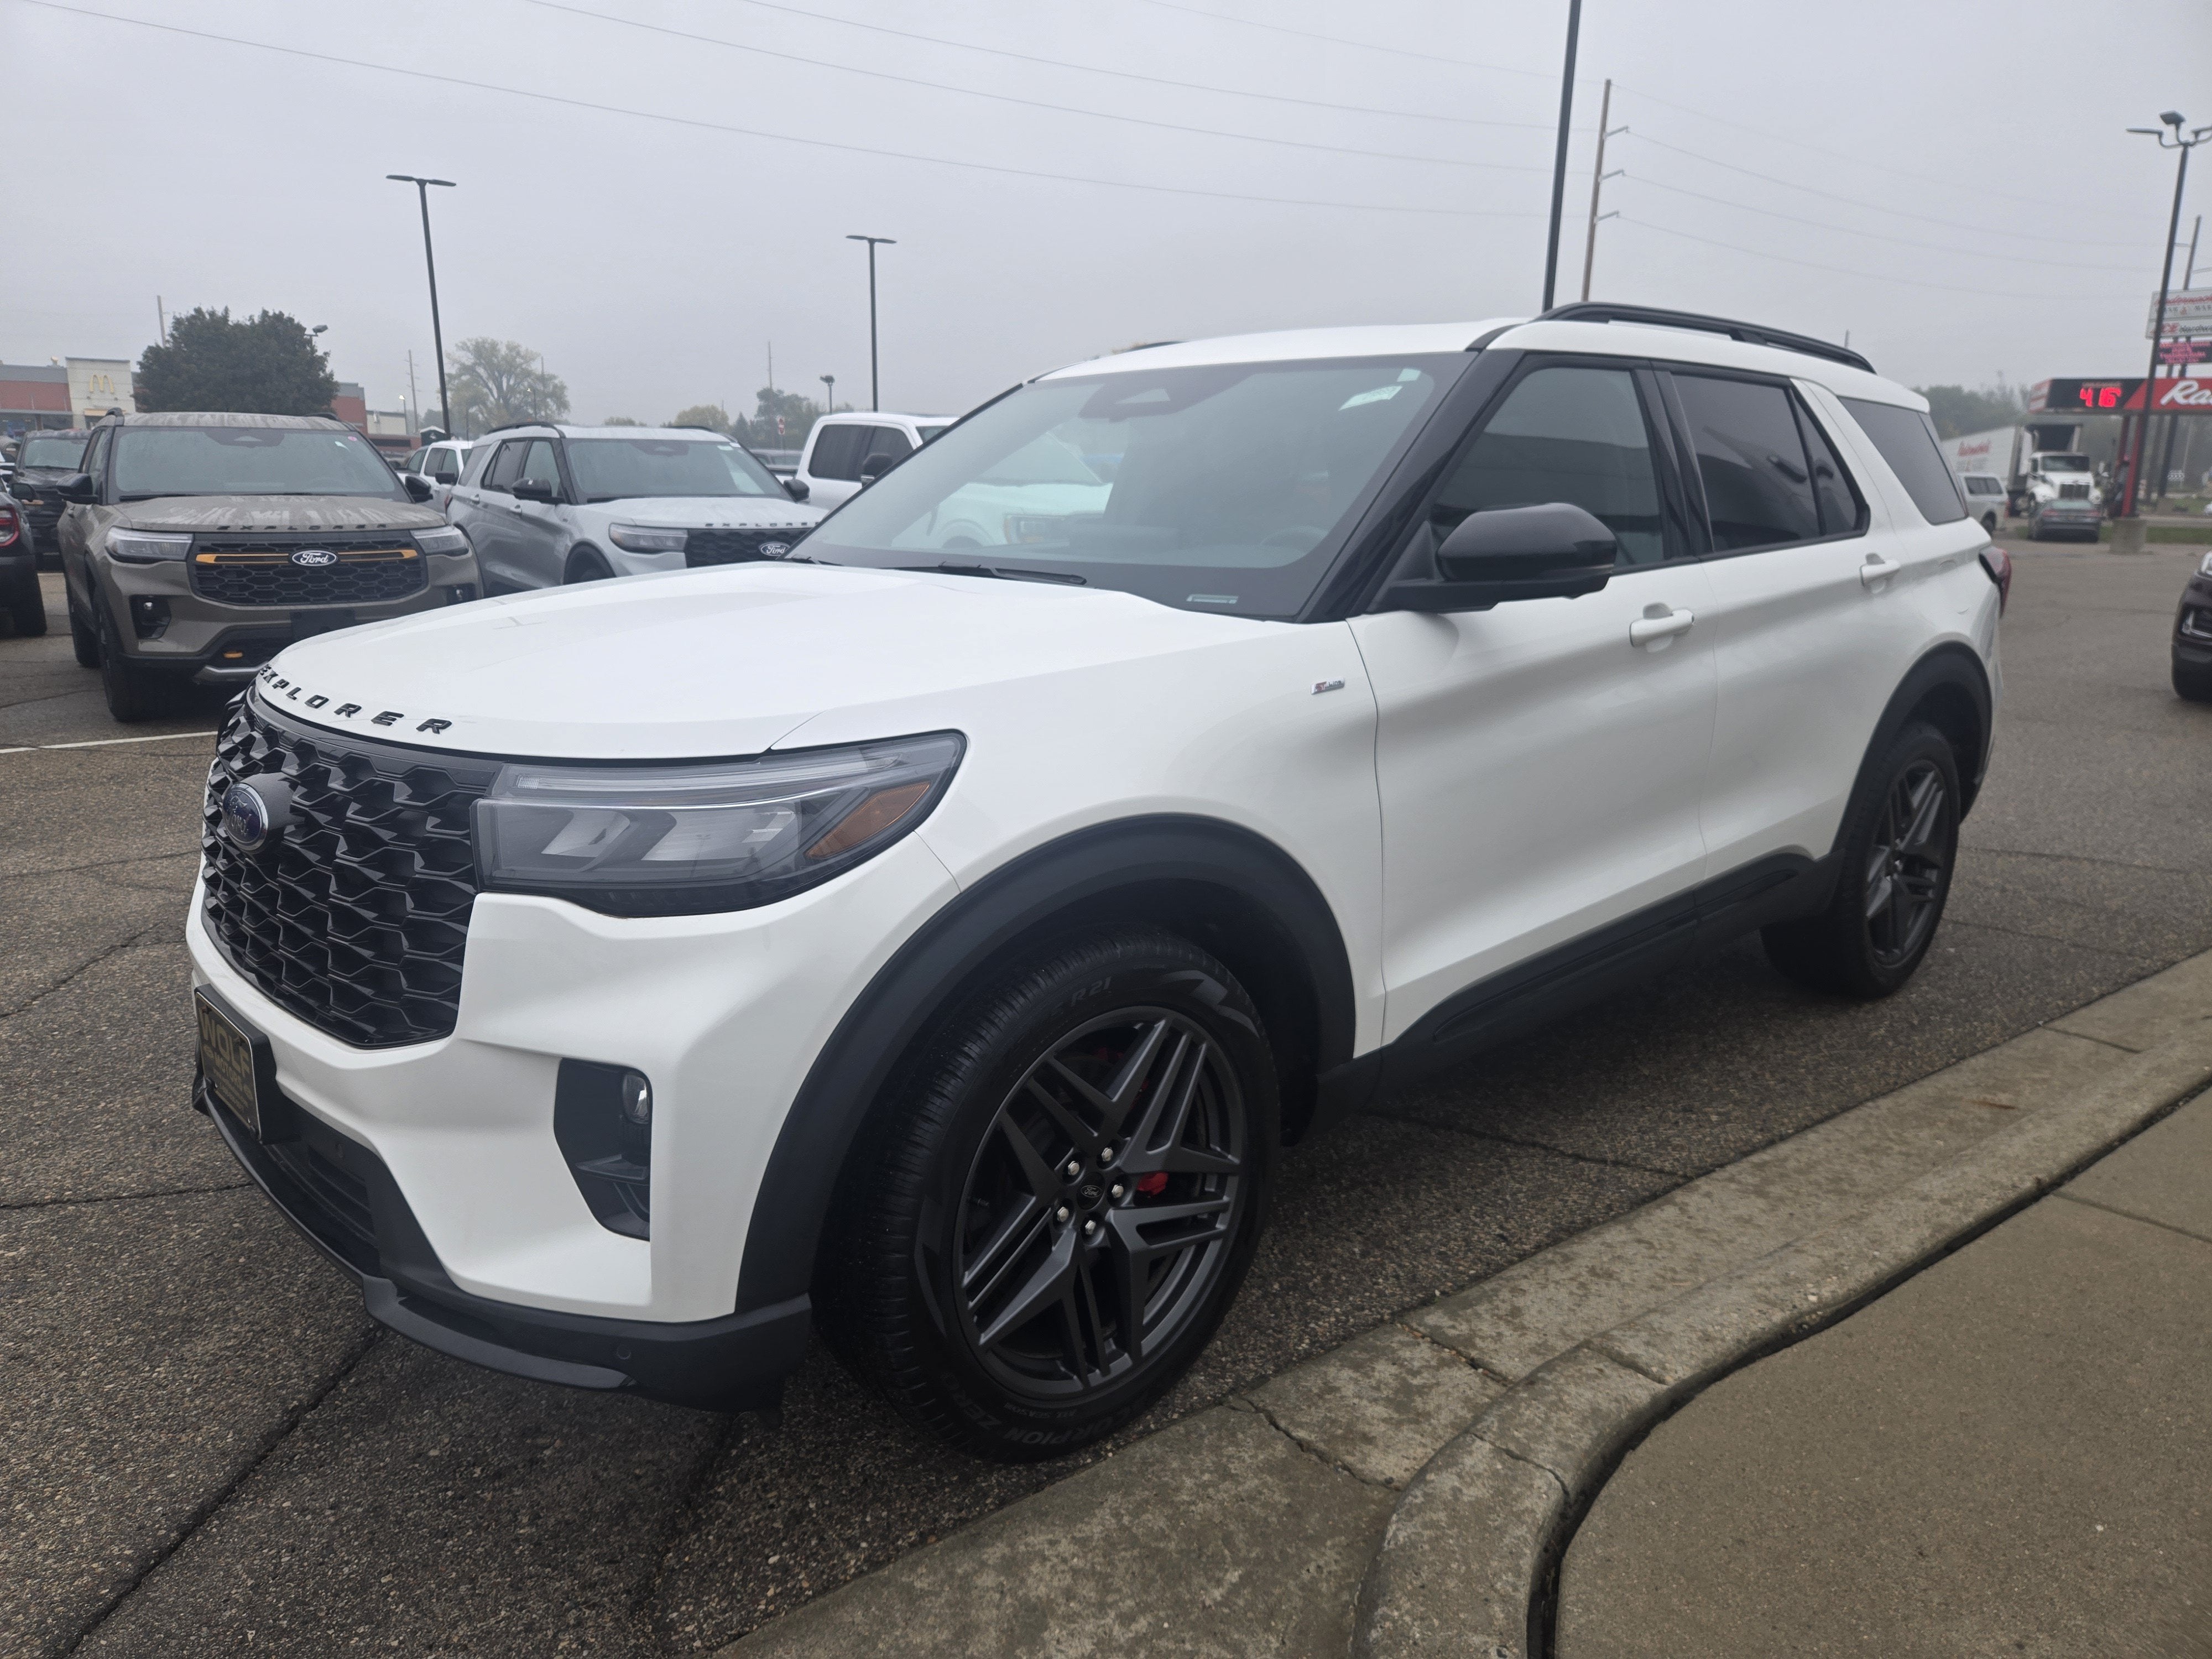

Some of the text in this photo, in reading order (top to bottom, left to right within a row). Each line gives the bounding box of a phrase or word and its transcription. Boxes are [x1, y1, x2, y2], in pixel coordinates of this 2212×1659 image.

[2160, 379, 2212, 405] Ra
[300, 552, 328, 564] Ford
[766, 545, 786, 554] Ford
[258, 664, 452, 734] EXPLORER
[199, 1006, 249, 1077] WOLF
[1084, 1187, 1099, 1196] Ford
